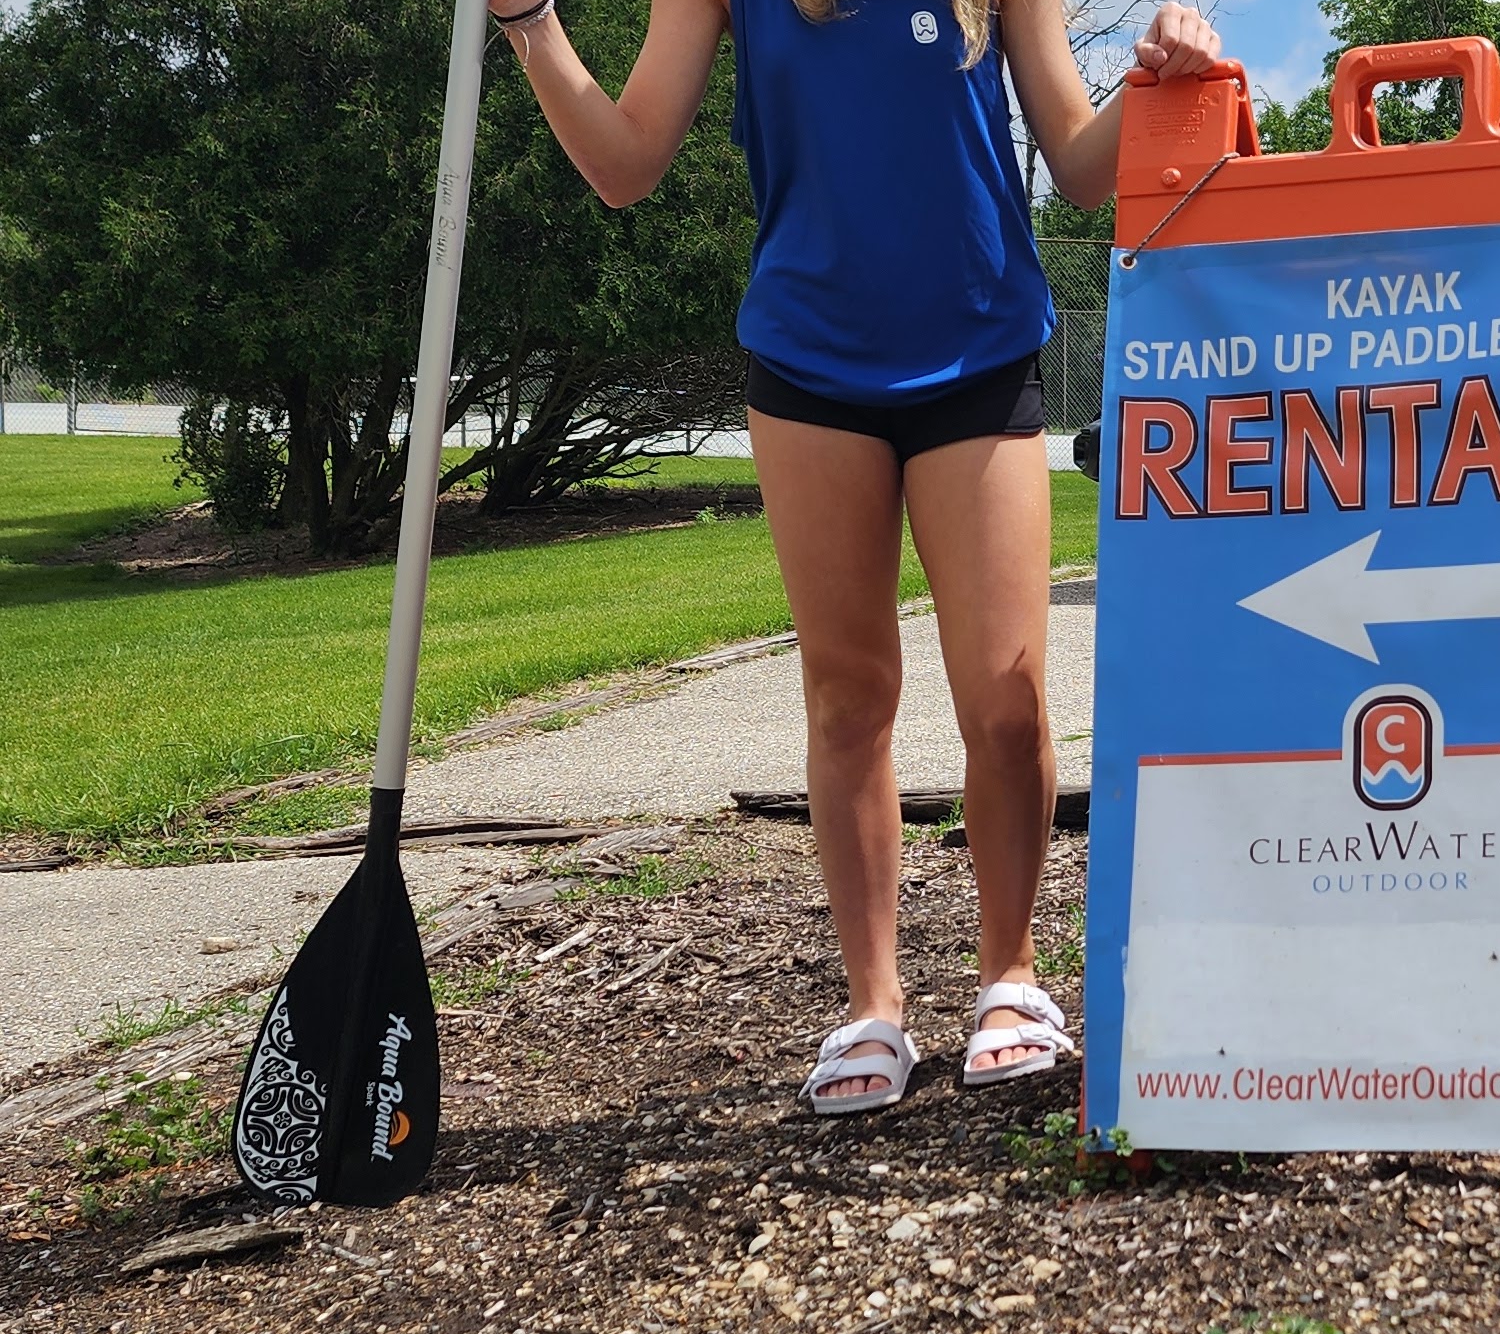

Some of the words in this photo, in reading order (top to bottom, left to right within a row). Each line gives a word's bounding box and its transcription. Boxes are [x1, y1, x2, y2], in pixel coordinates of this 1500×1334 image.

[1326, 271, 1462, 318] KAYAK
[1123, 336, 1256, 380] STAND
[1273, 333, 1332, 372] UP
[1312, 871, 1469, 894] OUTDOOR
[379, 1013, 412, 1077] Aqua
[365, 1081, 376, 1107] Spark
[372, 1081, 403, 1161] Bound
